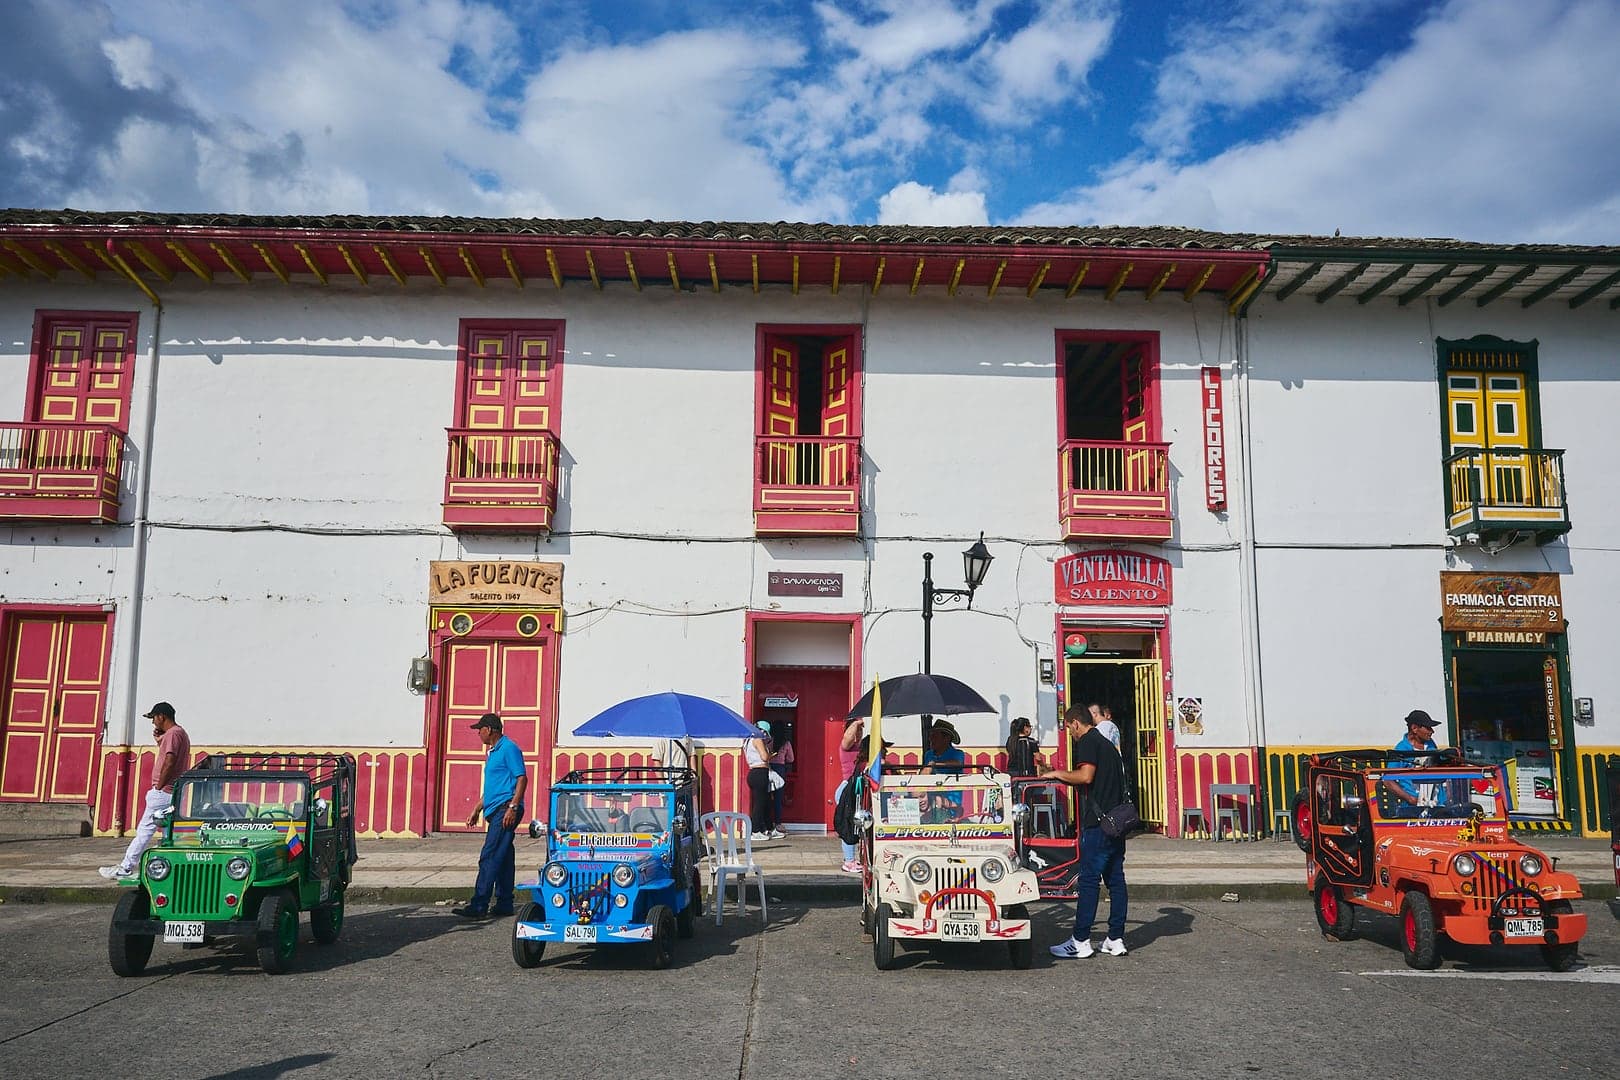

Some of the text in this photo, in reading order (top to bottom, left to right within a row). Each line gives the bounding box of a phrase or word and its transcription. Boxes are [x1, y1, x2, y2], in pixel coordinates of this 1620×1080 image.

[1061, 554, 1167, 591] VENTANILLA
[434, 563, 559, 595] LA FUENTE
[470, 592, 502, 601] SALENTO
[1070, 588, 1158, 600] SALENTO
[1446, 593, 1561, 607] FARMACIA CENTRAL
[1548, 610, 1558, 622] 2
[1468, 631, 1543, 643] PHARMACY
[1546, 675, 1556, 735] DROGUERIA
[215, 823, 274, 831] CONSENTIDO
[895, 828, 913, 838] El
[580, 834, 588, 846] El
[185, 852, 213, 861] WILLYS
[1487, 851, 1509, 859] Jeep
[187, 924, 202, 937] 538
[566, 926, 596, 938] SAL 790
[944, 923, 978, 936] QYA 538
[1507, 920, 1542, 932] QML 785
